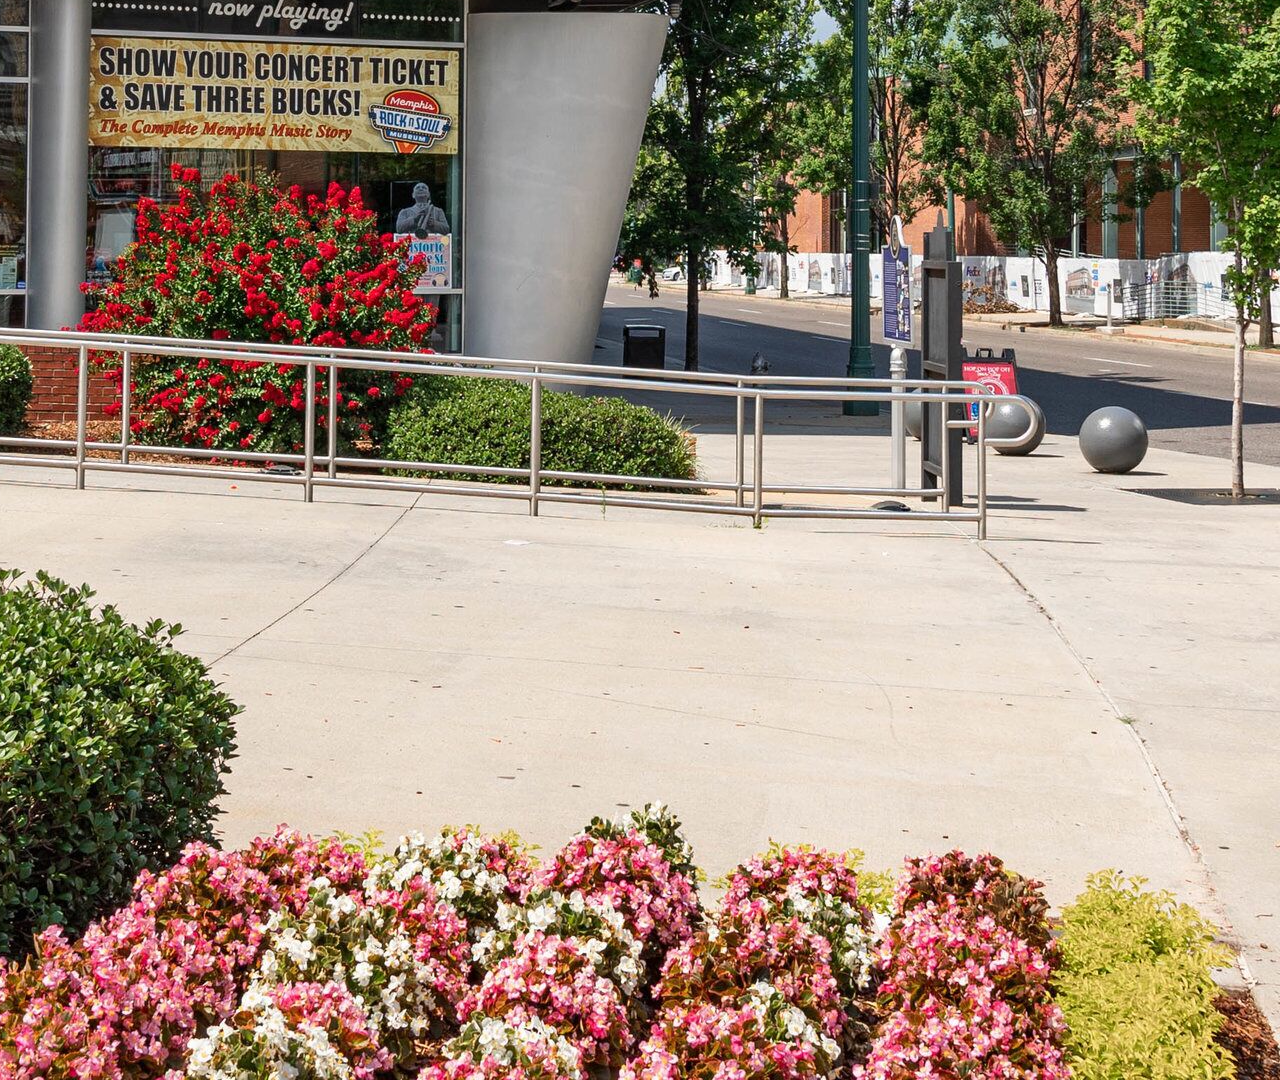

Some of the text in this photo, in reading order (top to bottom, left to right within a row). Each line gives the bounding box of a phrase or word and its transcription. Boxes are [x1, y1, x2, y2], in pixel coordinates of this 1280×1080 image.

[208, 0, 255, 17] now
[99, 46, 449, 88] SHOW YOUR CONCERT TICKET
[99, 82, 362, 118] & SAVE THREE BUCKS!
[389, 96, 436, 111] Memphis
[99, 118, 353, 142] The Complete Memphis Music Story
[379, 111, 440, 134] ROCK n SOUL
[966, 266, 980, 277] FedEx
